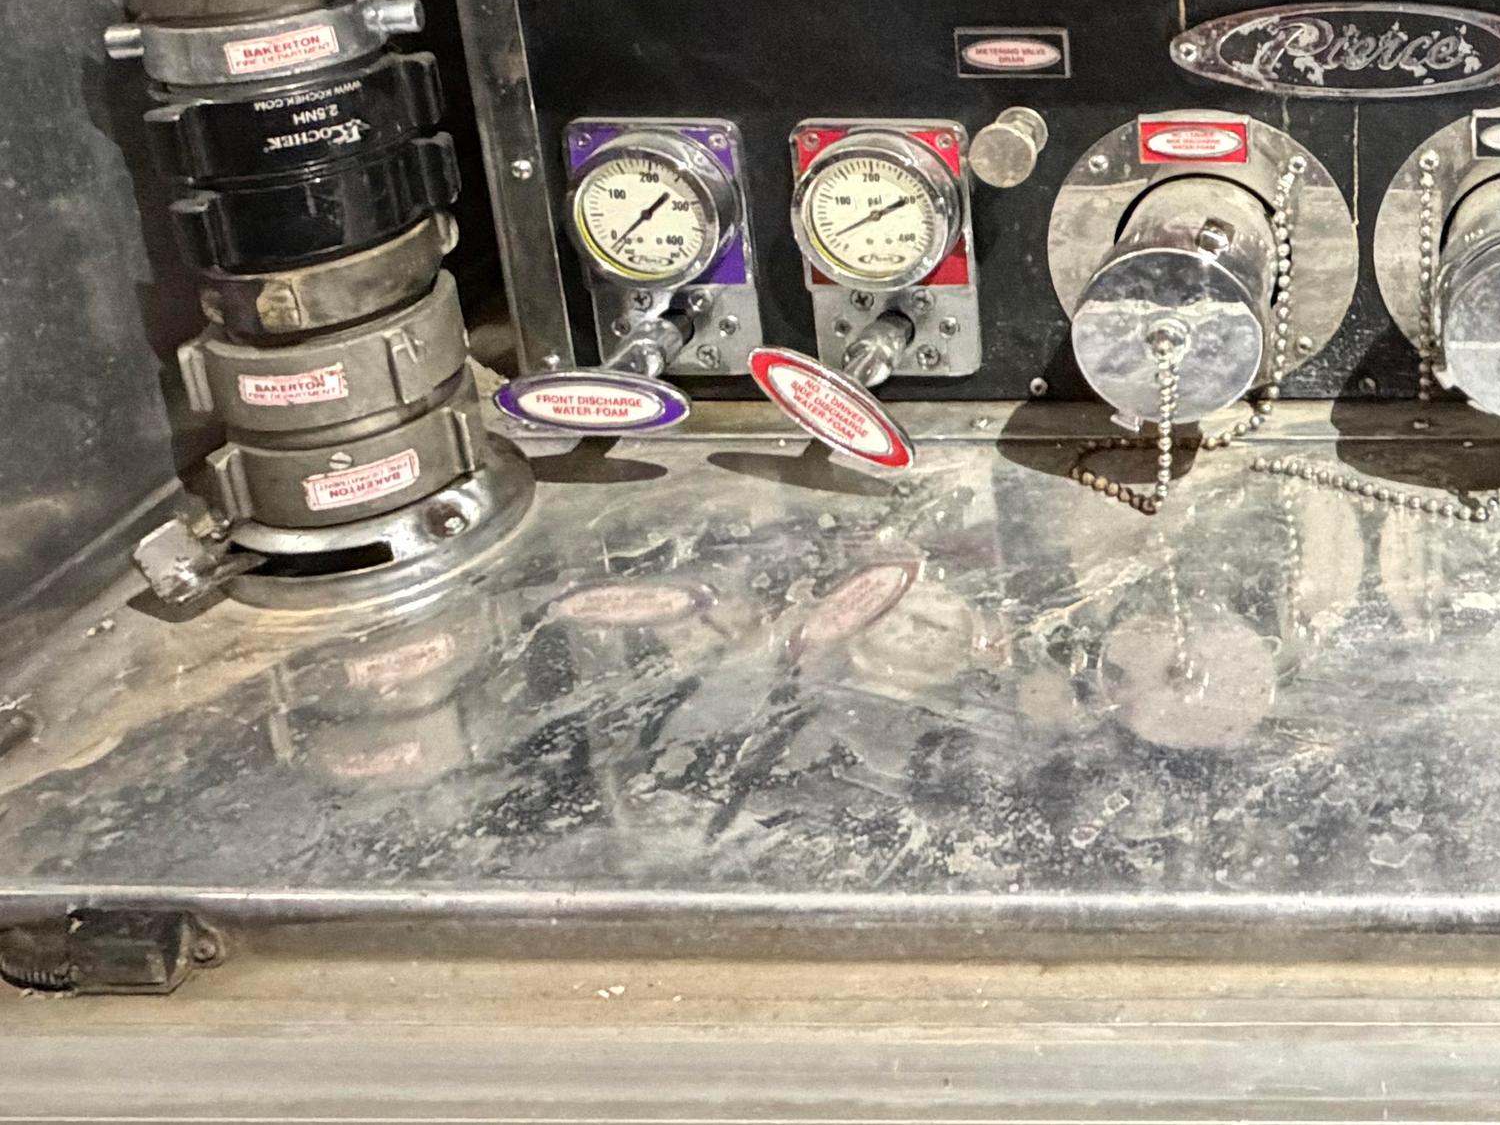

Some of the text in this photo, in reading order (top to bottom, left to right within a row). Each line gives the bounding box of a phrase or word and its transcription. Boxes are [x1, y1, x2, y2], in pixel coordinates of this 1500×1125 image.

[243, 35, 320, 58] BAKERTON
[292, 104, 339, 125] 2.5NH
[265, 119, 363, 151] KOCHEK
[640, 172, 660, 183] 200
[863, 173, 880, 183] 200
[608, 189, 626, 199] 100
[835, 195, 851, 205] 100
[868, 195, 882, 206] psi
[671, 202, 689, 211] 300
[611, 230, 617, 240] 0
[666, 235, 683, 245] 400
[255, 381, 325, 393] BAKERTON
[536, 395, 642, 407] FRONT DISCHARGE
[552, 406, 629, 417] WATER-FOAM
[791, 380, 869, 438] SIDE DISCHARGE
[831, 394, 866, 424] DRIVER
[793, 393, 856, 440] WATER-FOAM
[329, 472, 401, 499] BAKERTON
